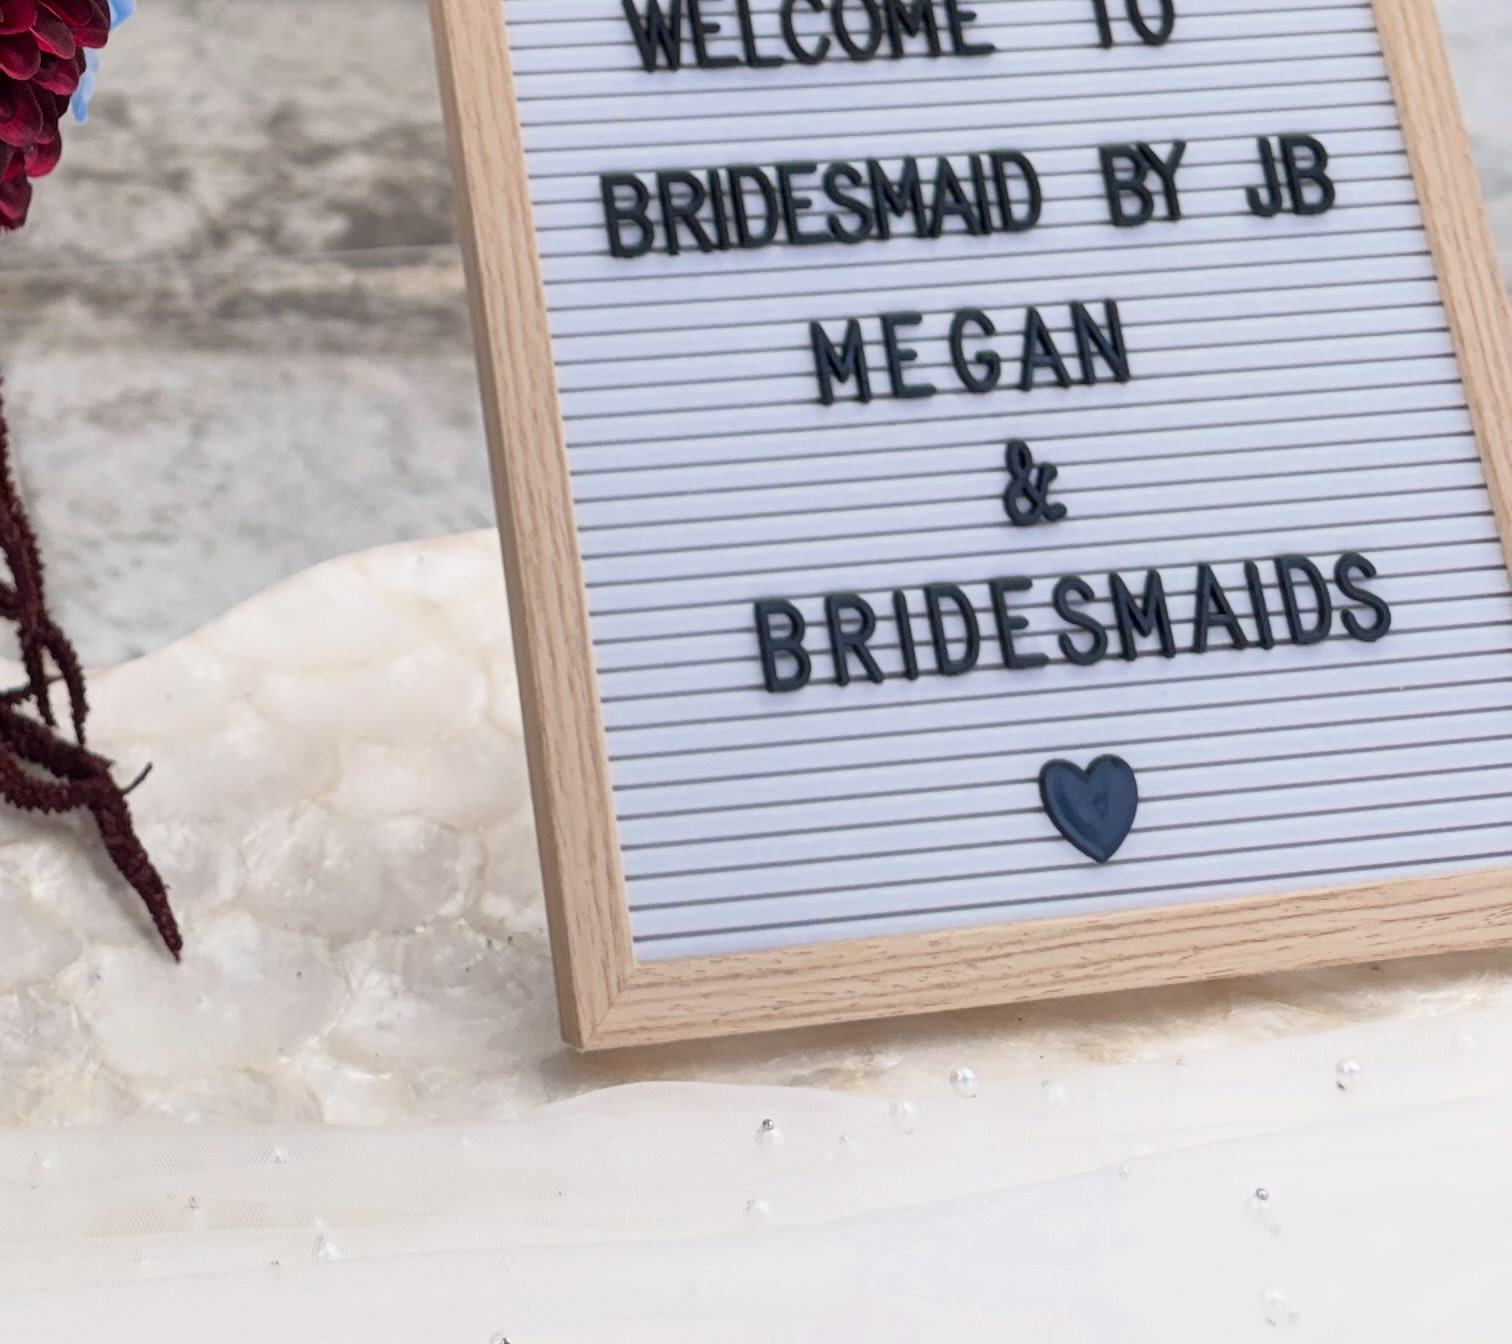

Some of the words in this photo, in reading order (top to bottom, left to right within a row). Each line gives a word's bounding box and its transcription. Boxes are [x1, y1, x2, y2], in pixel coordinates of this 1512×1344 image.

[600, 150, 1042, 257] BRIDESMAID
[1100, 141, 1186, 225] BY
[1244, 134, 1337, 218] JB
[809, 299, 1131, 405] MEGAN
[1002, 439, 1068, 526] &
[753, 553, 1391, 693] BRIDESMAIDS
